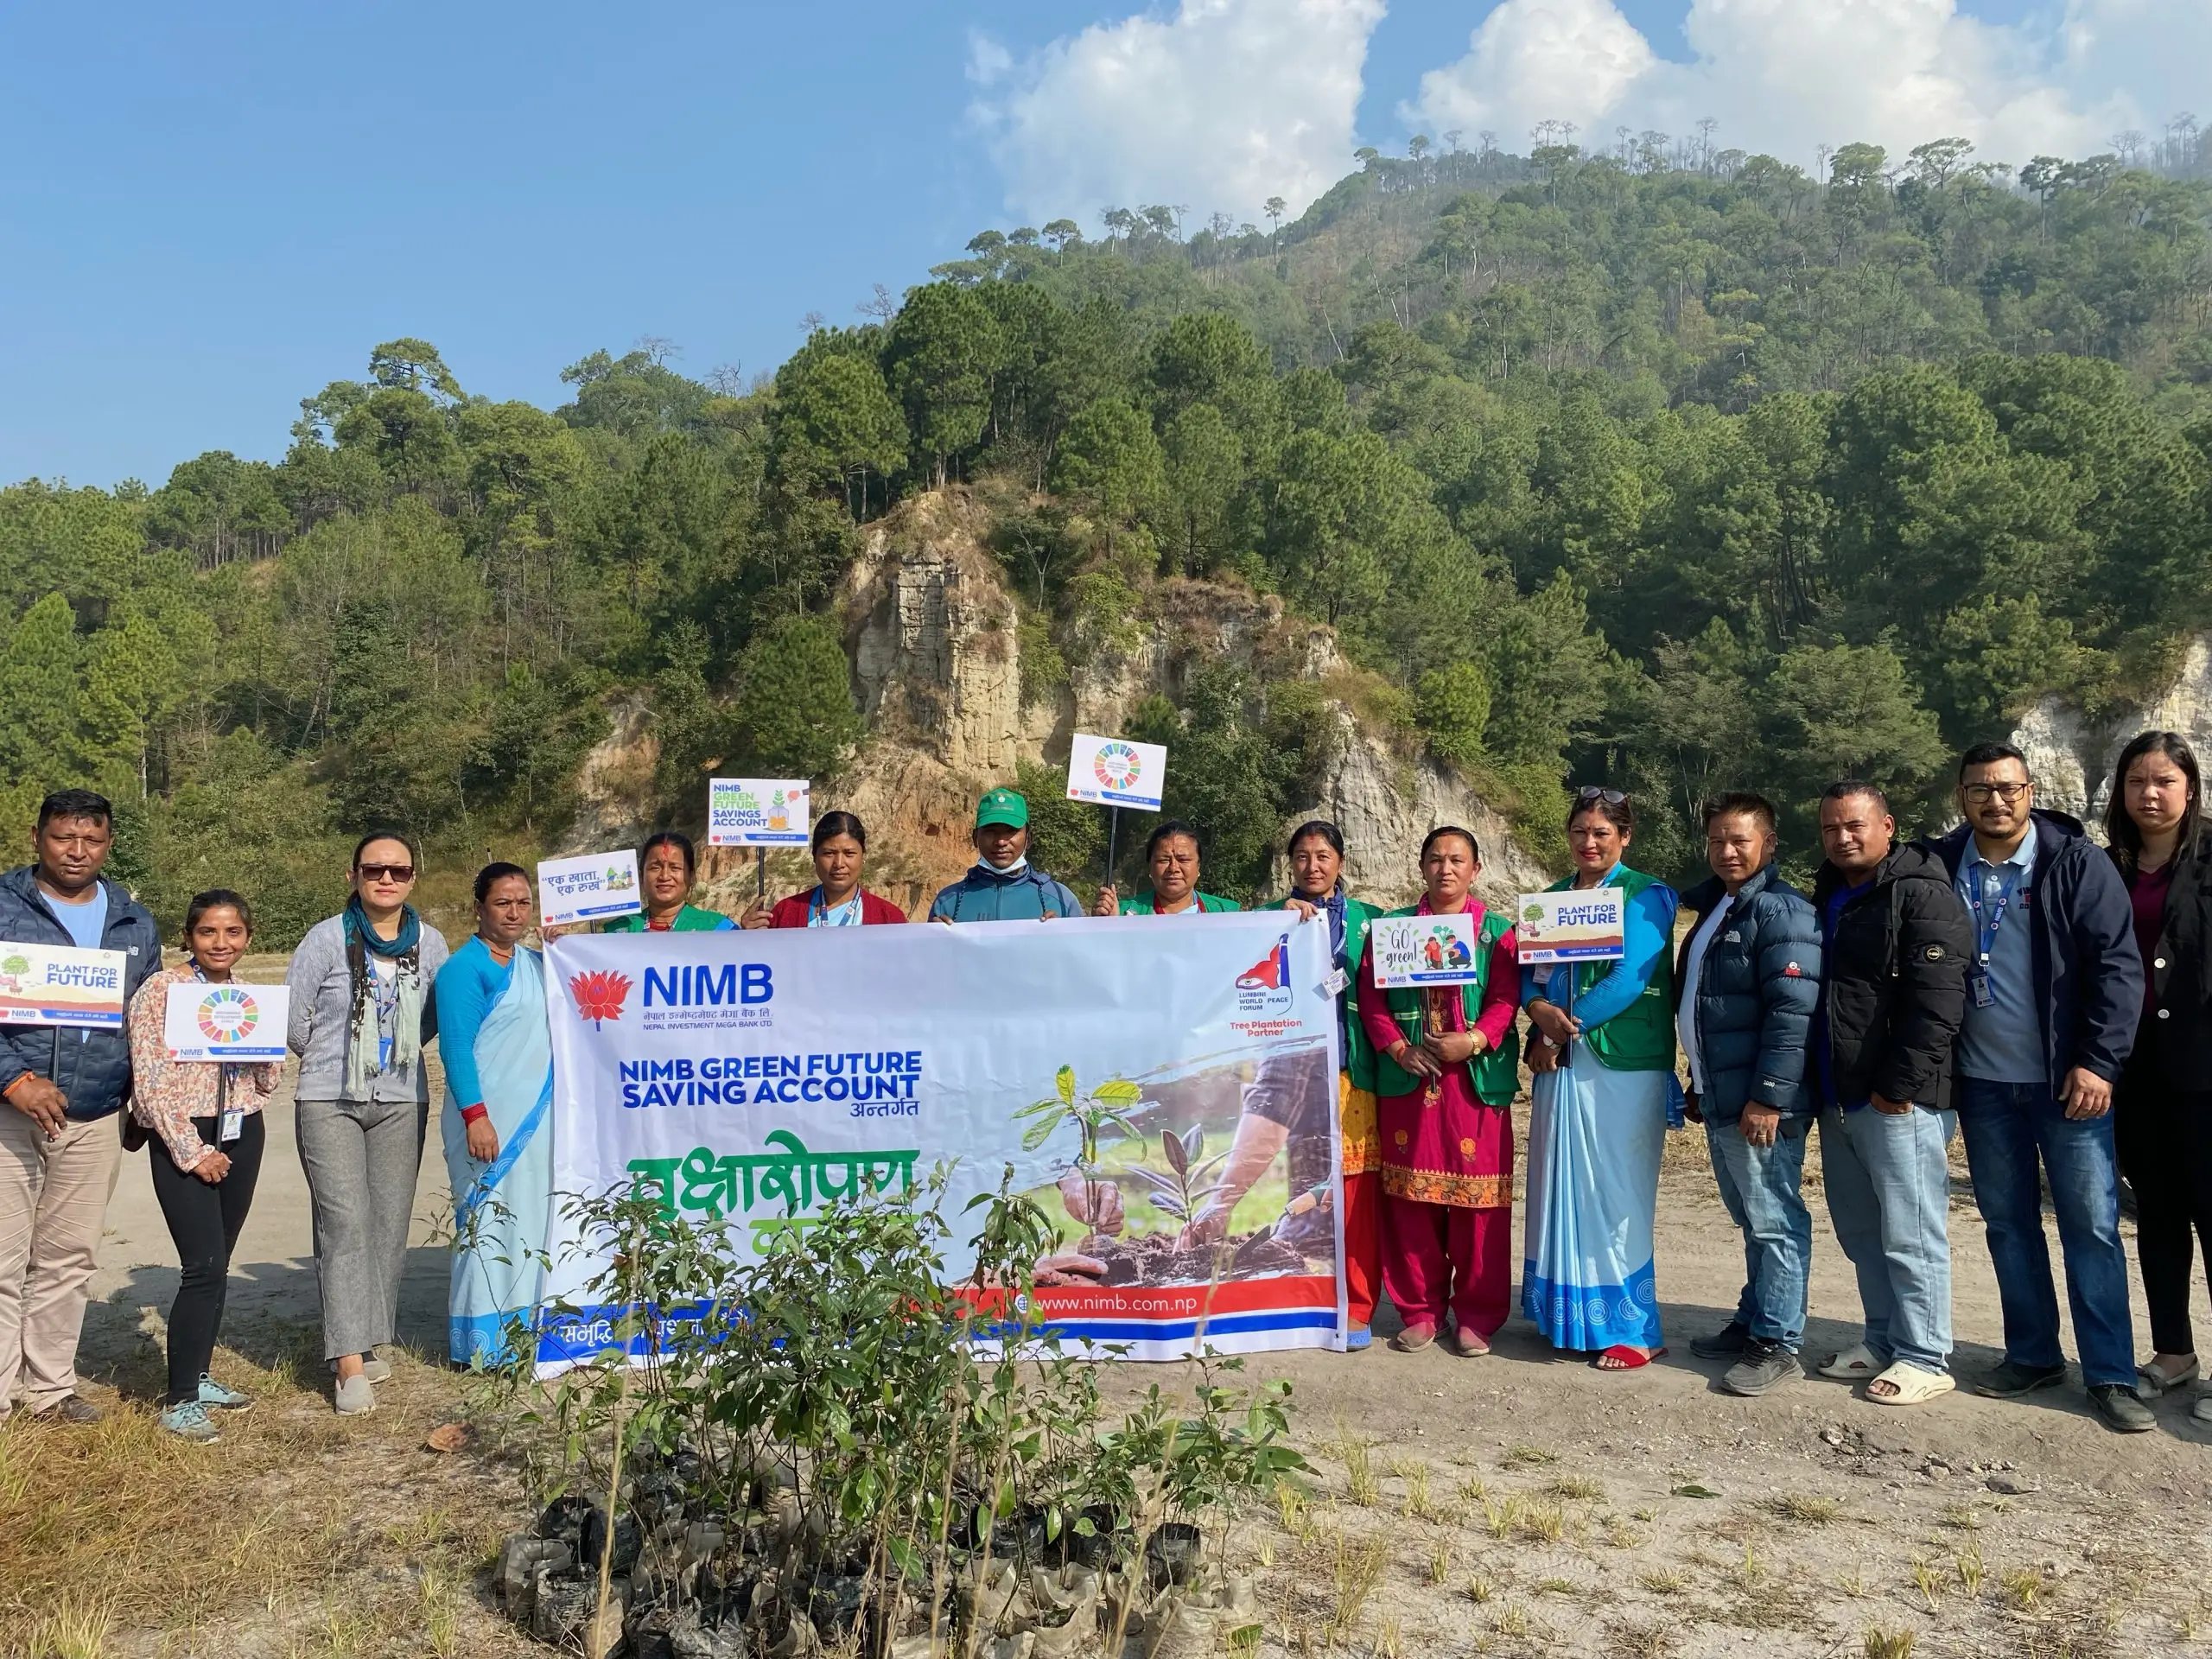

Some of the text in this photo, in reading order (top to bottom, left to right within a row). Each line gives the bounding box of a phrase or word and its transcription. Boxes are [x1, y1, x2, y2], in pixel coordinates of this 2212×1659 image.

[714, 792, 754, 801] GREEN
[713, 801, 760, 810] FUTURE
[713, 810, 760, 818] SAVINGS
[557, 885, 575, 896] एक
[1558, 904, 1616, 915] PLANT FOR
[1558, 912, 1617, 926] FUTURE
[1391, 929, 1409, 950] GO
[1386, 941, 1417, 968] green!
[48, 963, 118, 976] PLANT FOR
[47, 973, 118, 988] FUTURE
[644, 963, 773, 1007] NIMB
[643, 1011, 665, 1020] नेपाल
[1251, 1019, 1302, 1029] Plantation
[1247, 1028, 1284, 1037] Partner
[620, 1051, 923, 1083] NIMB GREEN FUTURE
[622, 1073, 920, 1109] SAVING ACCOUNT
[850, 1098, 921, 1117] अन्तर्गत
[1039, 1294, 1198, 1315] www.nimb.com.np
